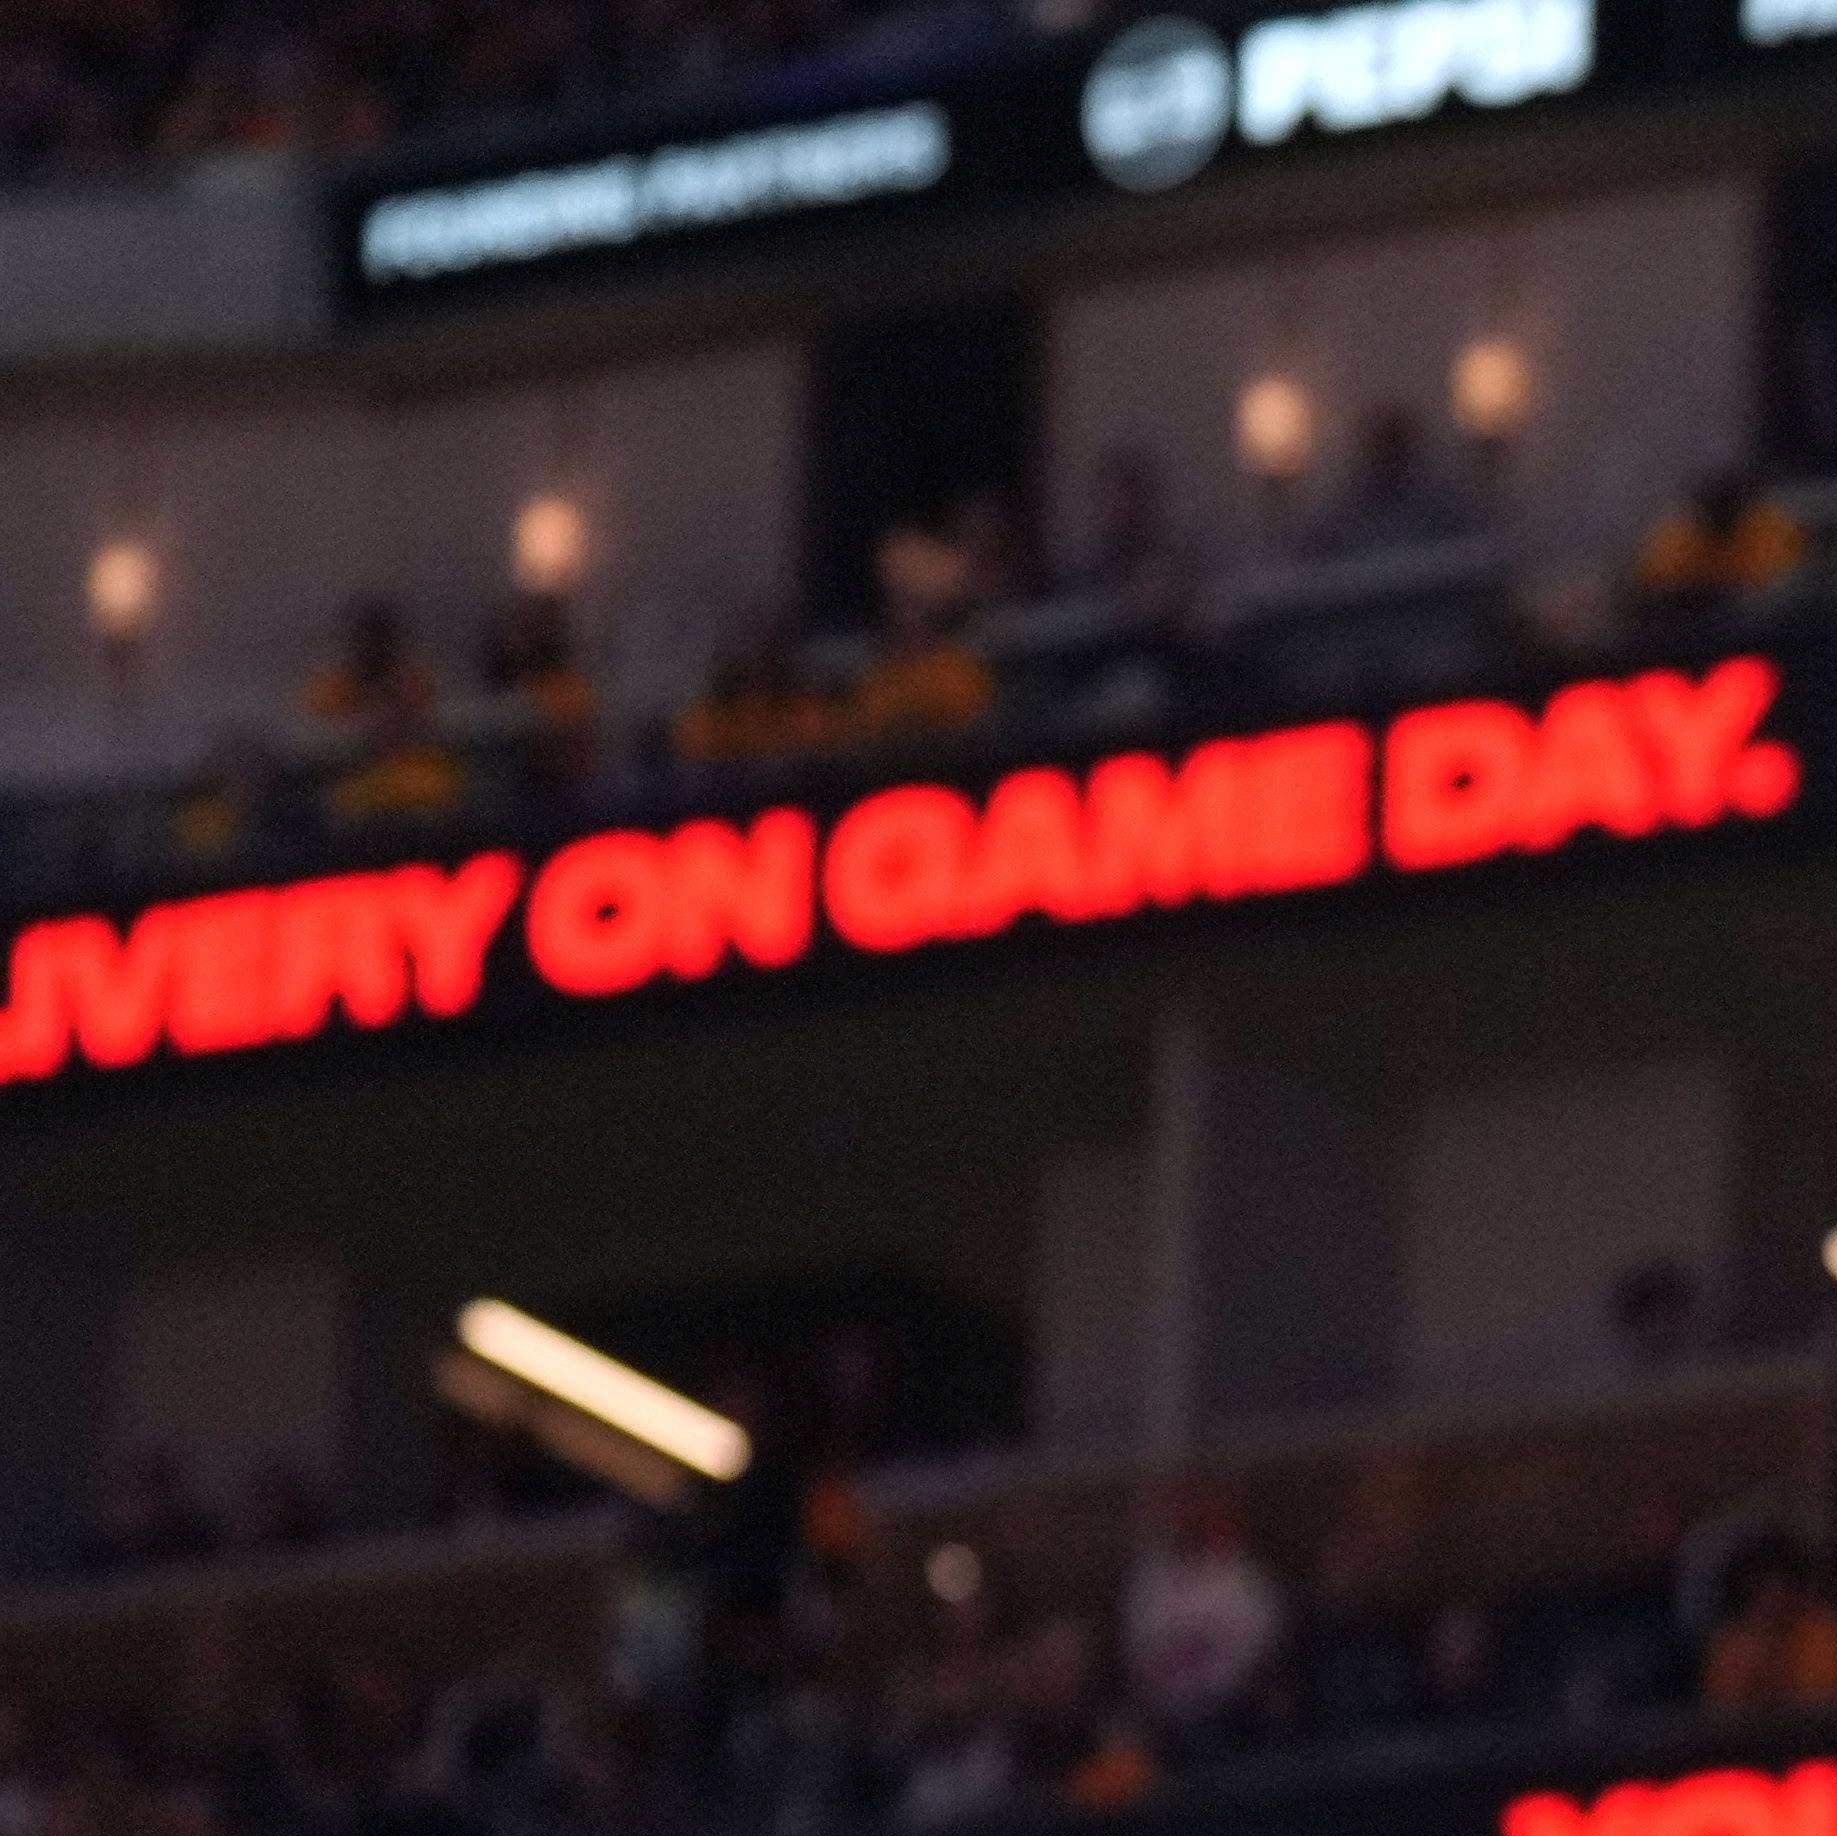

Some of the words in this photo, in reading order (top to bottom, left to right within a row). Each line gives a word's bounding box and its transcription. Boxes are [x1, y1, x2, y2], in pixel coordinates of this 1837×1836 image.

[526, 806, 818, 998] ON
[820, 717, 1374, 955] GAME
[1382, 654, 1800, 874] DAY.
